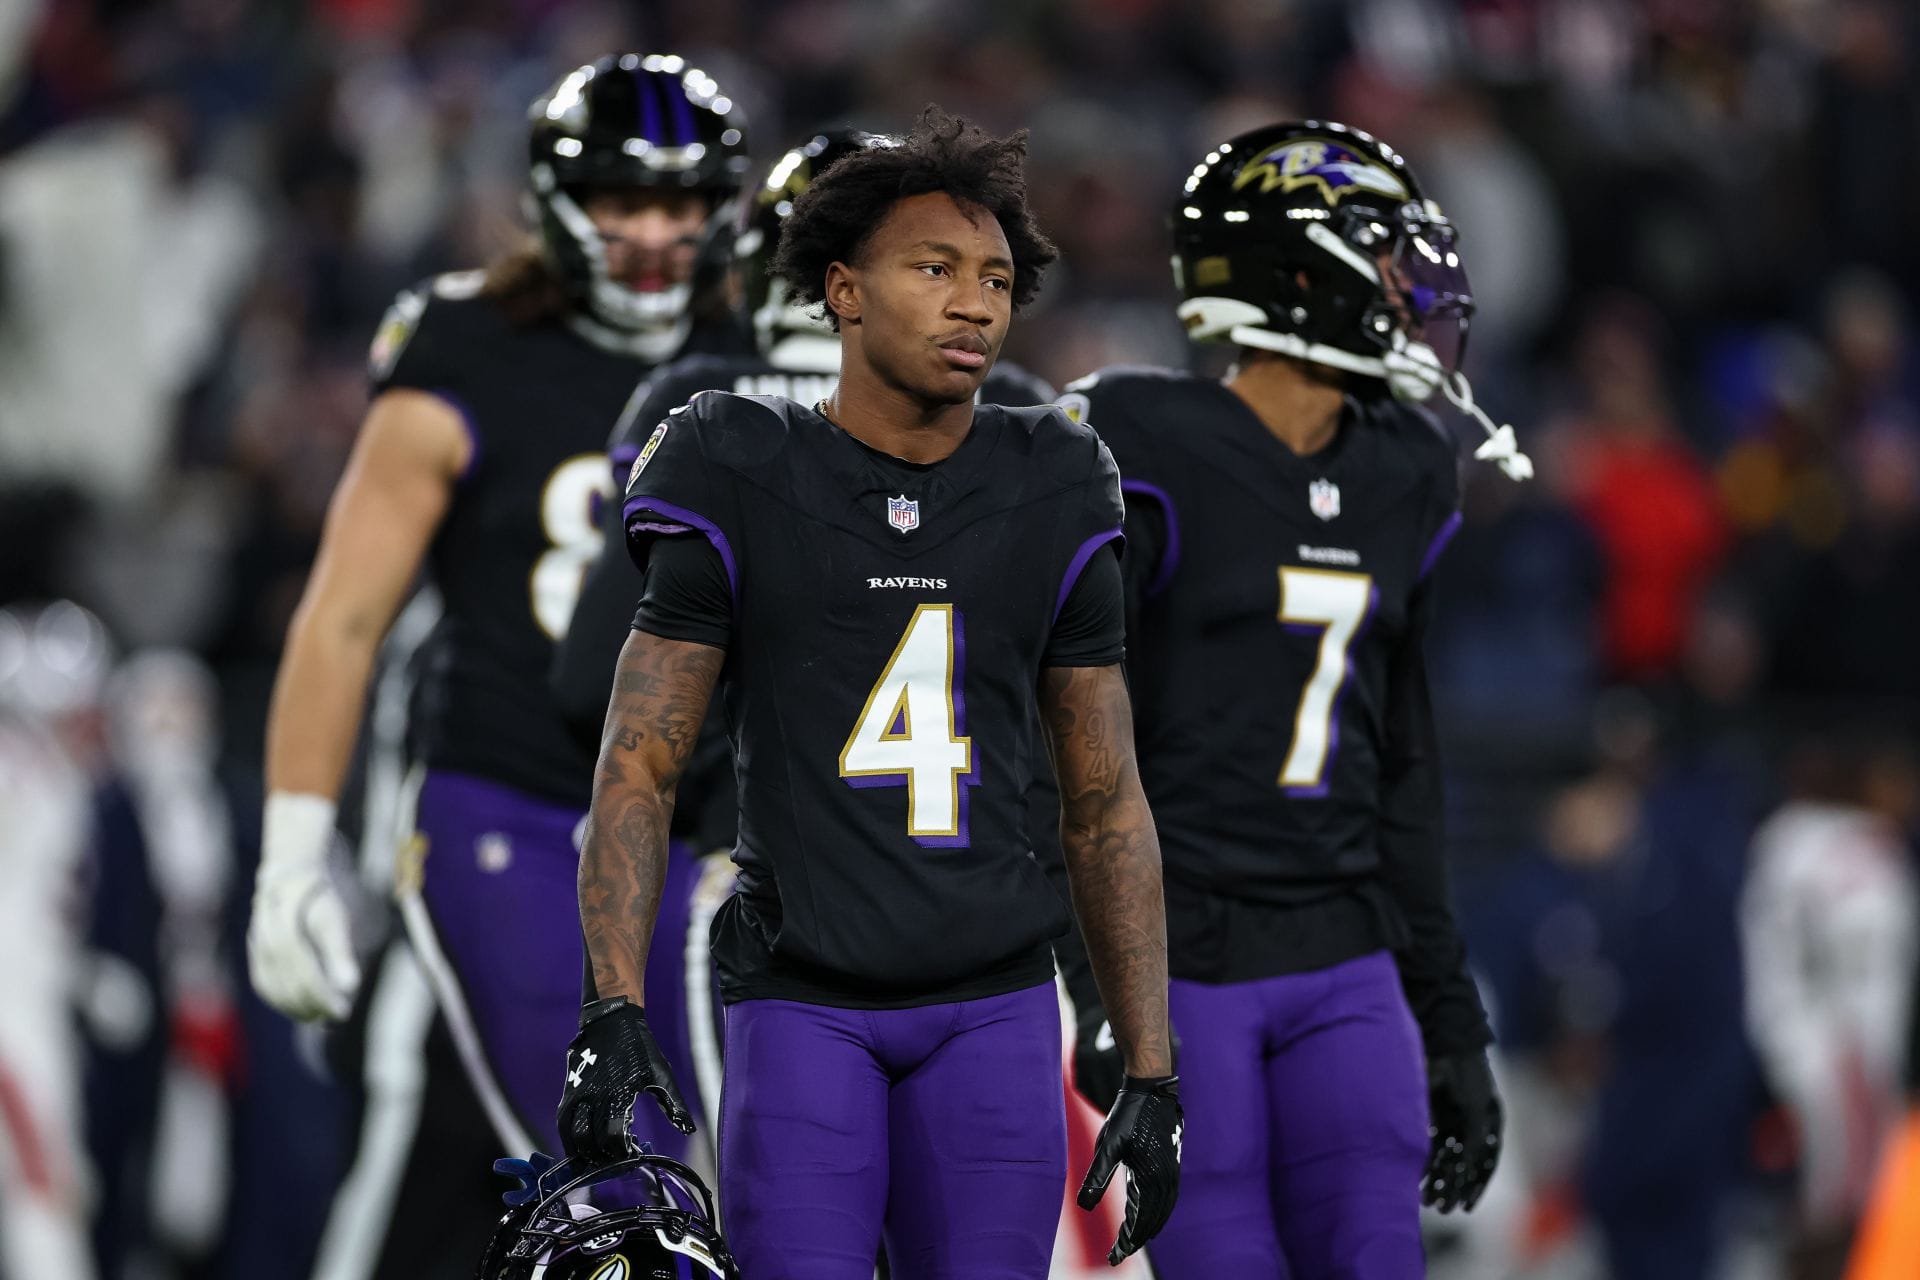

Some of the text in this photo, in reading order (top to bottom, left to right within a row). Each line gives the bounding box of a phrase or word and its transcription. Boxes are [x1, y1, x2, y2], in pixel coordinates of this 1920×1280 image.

[894, 510, 915, 525] NFL
[866, 576, 948, 590] RAVENS
[838, 602, 982, 849] 4
[1277, 565, 1380, 798] 7
